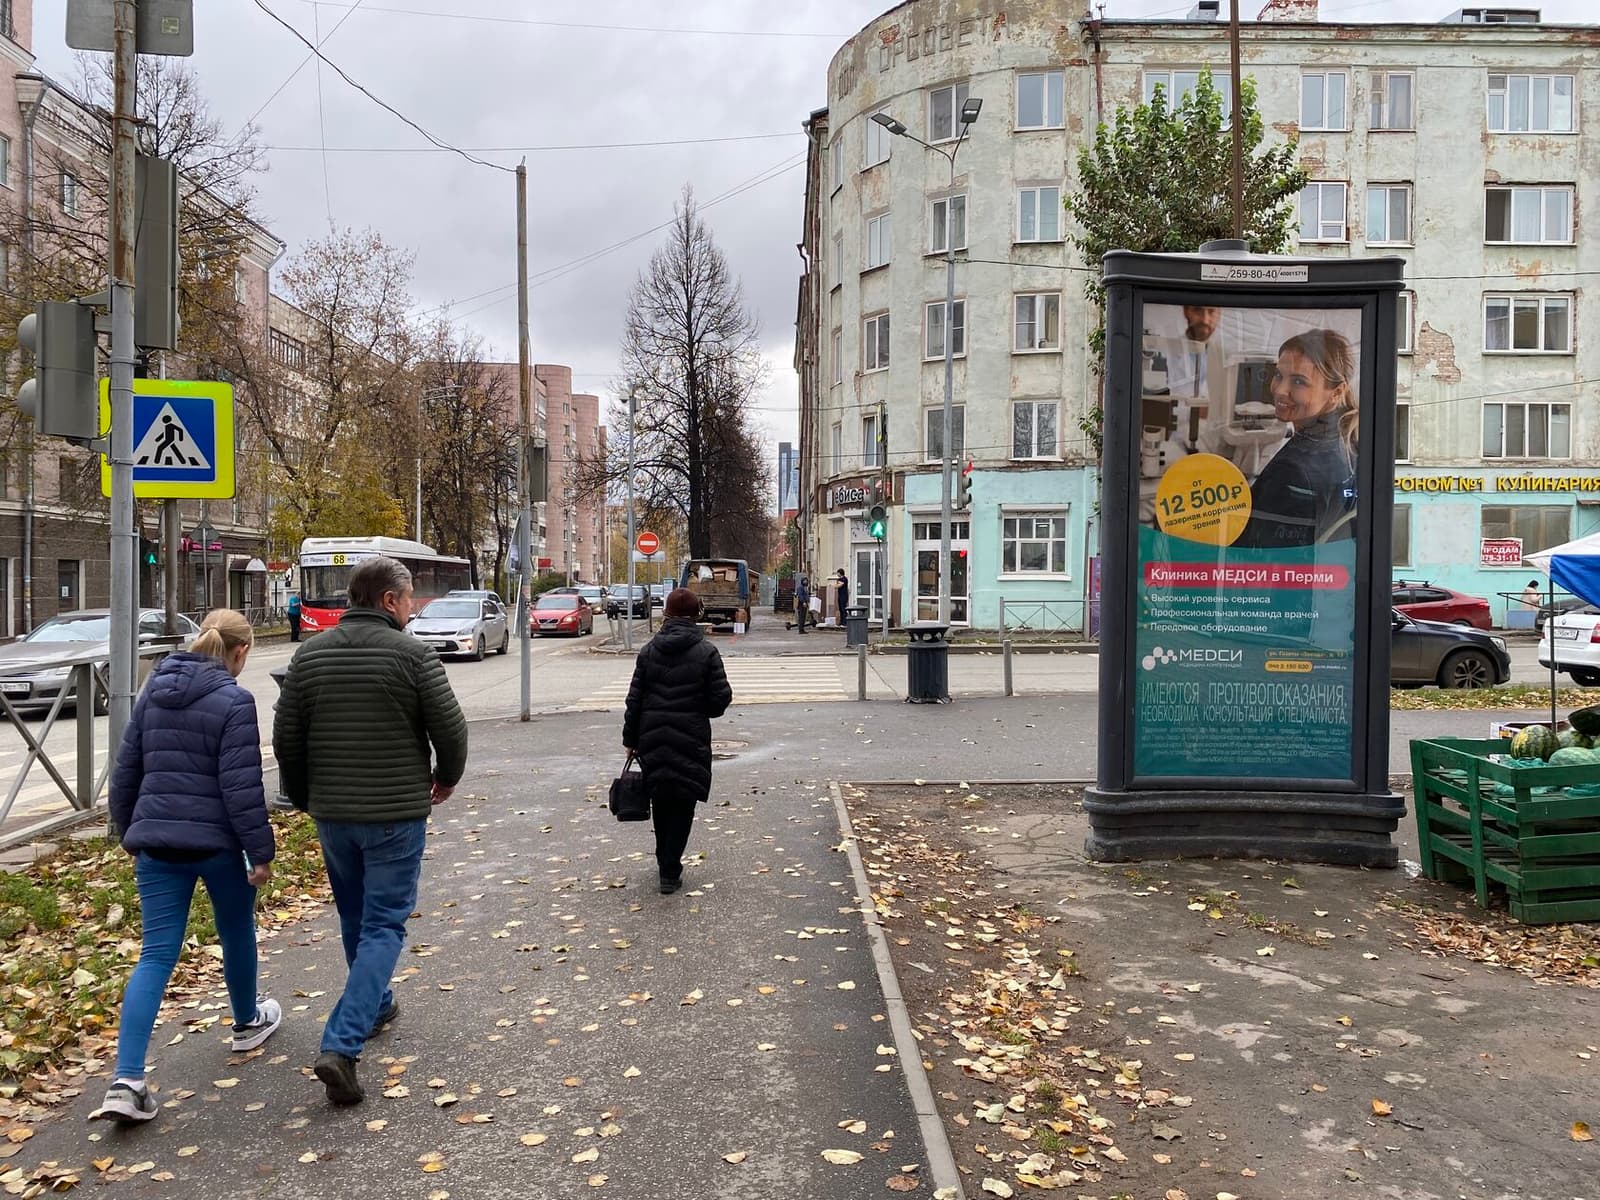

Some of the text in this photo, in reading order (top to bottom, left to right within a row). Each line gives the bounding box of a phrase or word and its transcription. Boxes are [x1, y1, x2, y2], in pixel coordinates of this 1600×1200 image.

[1230, 269, 1278, 279] 259-80-40
[1192, 480, 1202, 488] от
[1458, 476, 1485, 492] №1
[1496, 475, 1600, 492] КУЛИНАРИЯ
[1160, 495, 1185, 516] 12
[1165, 502, 1247, 528] лазерная коррекция
[1192, 518, 1221, 531] зрения
[333, 555, 345, 564] 68
[1151, 568, 1334, 585] Клиника МЕДСИ в Перми
[1151, 593, 1271, 606] Высокий уровень сервиса
[1150, 608, 1320, 620] Профессиональная команда врачей
[1150, 622, 1268, 634] Передовое оборудование
[1142, 682, 1200, 705] ИМЕЮТСЯ
[1140, 705, 1199, 725] НЕОБХОДИМА
[1203, 705, 1274, 726] КОНСУЛЬТАЦИЯ
